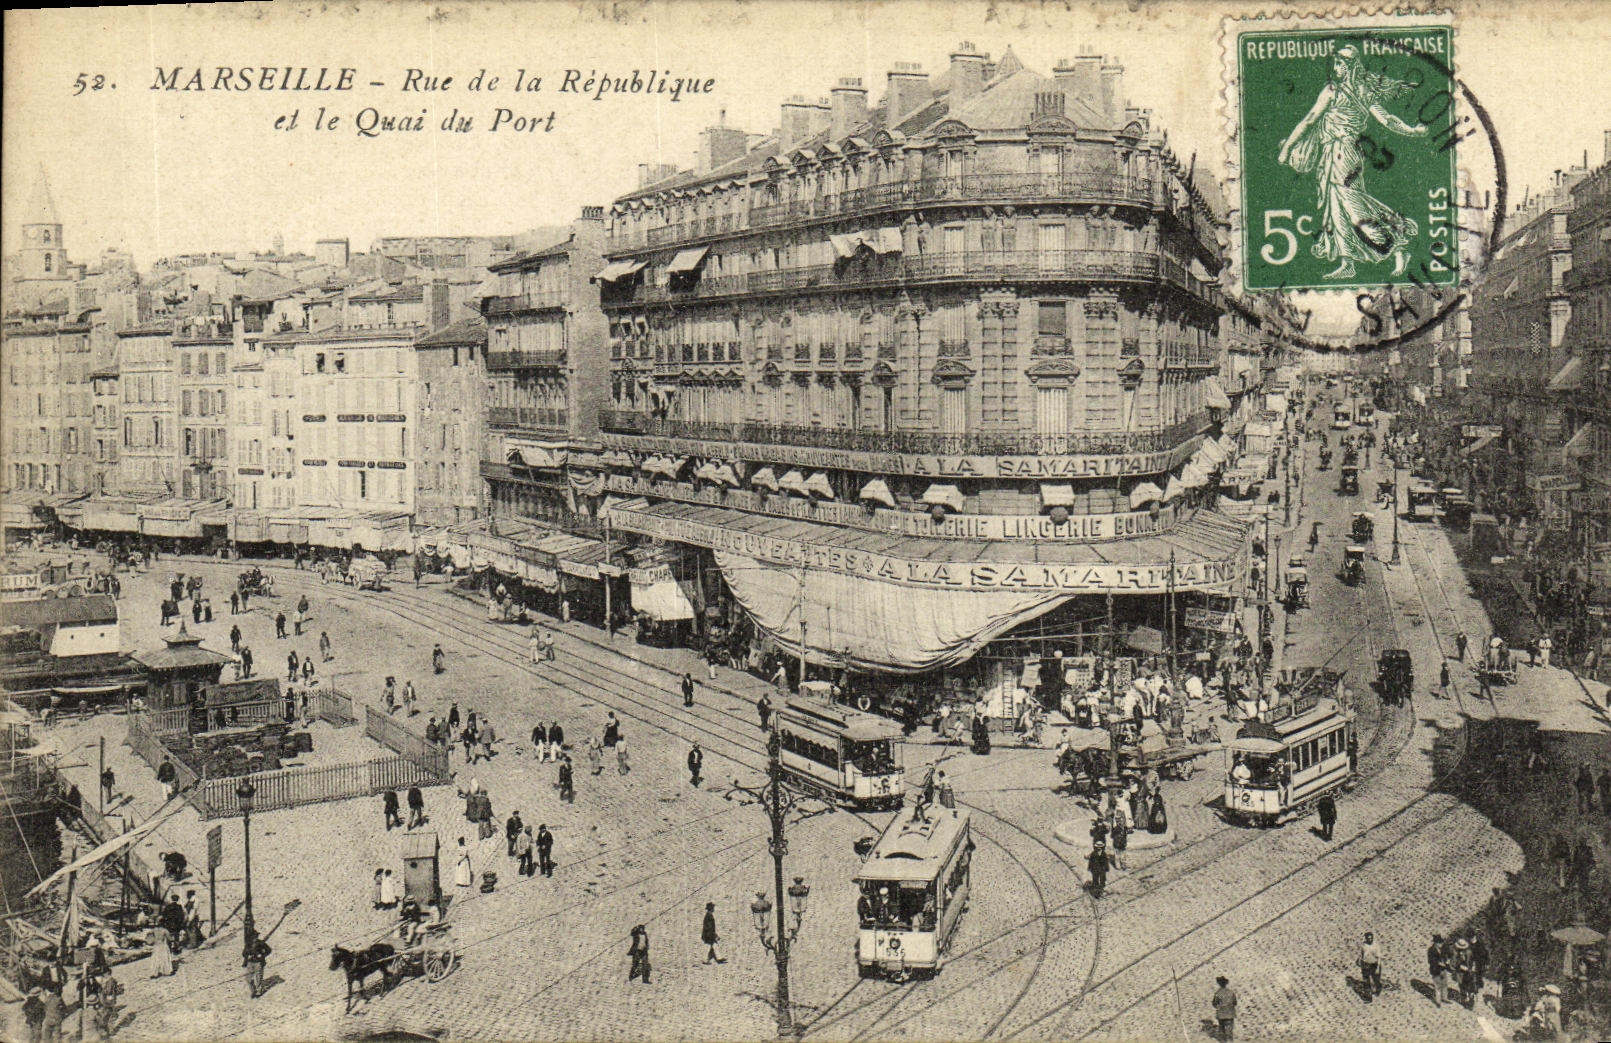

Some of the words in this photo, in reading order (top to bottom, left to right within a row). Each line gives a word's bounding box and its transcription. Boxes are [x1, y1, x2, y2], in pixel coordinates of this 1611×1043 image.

[1247, 38, 1336, 61] REPUBLIQUE
[1362, 36, 1445, 57] FRANÇAISE
[1428, 186, 1448, 273] POSTES
[914, 457, 931, 475] A
[937, 458, 984, 476] LA
[1003, 516, 1102, 538] LINGERIE
[878, 558, 902, 580] A
[907, 562, 963, 585] LA
